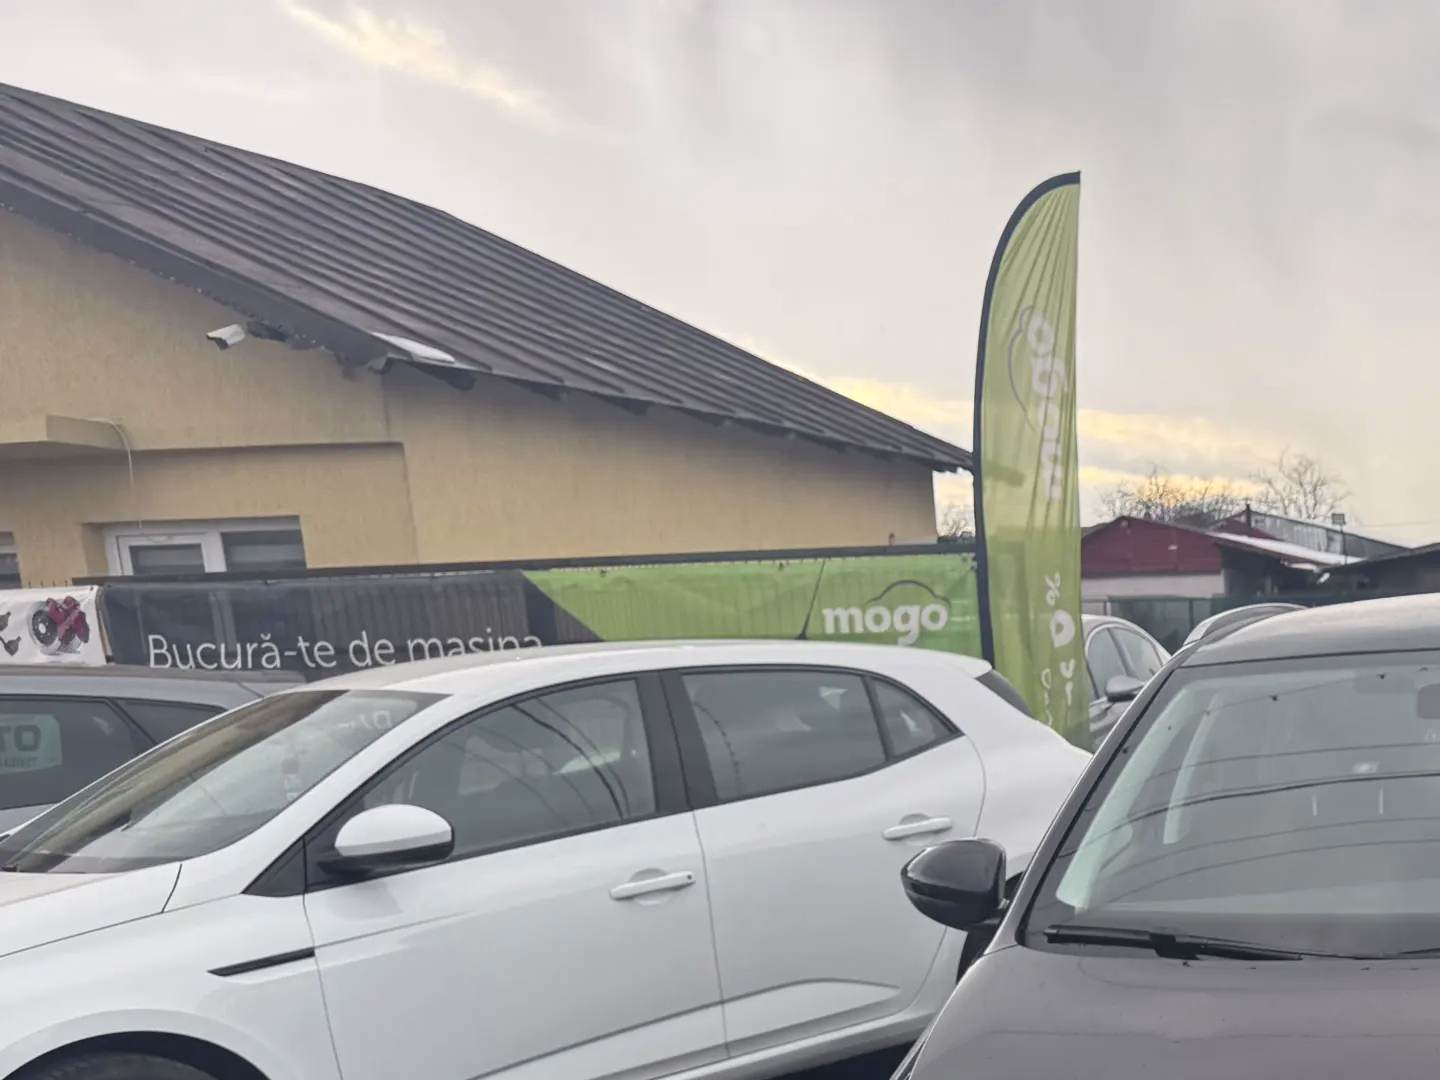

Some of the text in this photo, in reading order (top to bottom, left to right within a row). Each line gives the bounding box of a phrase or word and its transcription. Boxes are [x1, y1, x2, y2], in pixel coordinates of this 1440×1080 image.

[1026, 313, 1069, 500] mogo
[822, 602, 948, 646] mogo
[147, 632, 338, 669] Bucură-te
[348, 629, 396, 667] de
